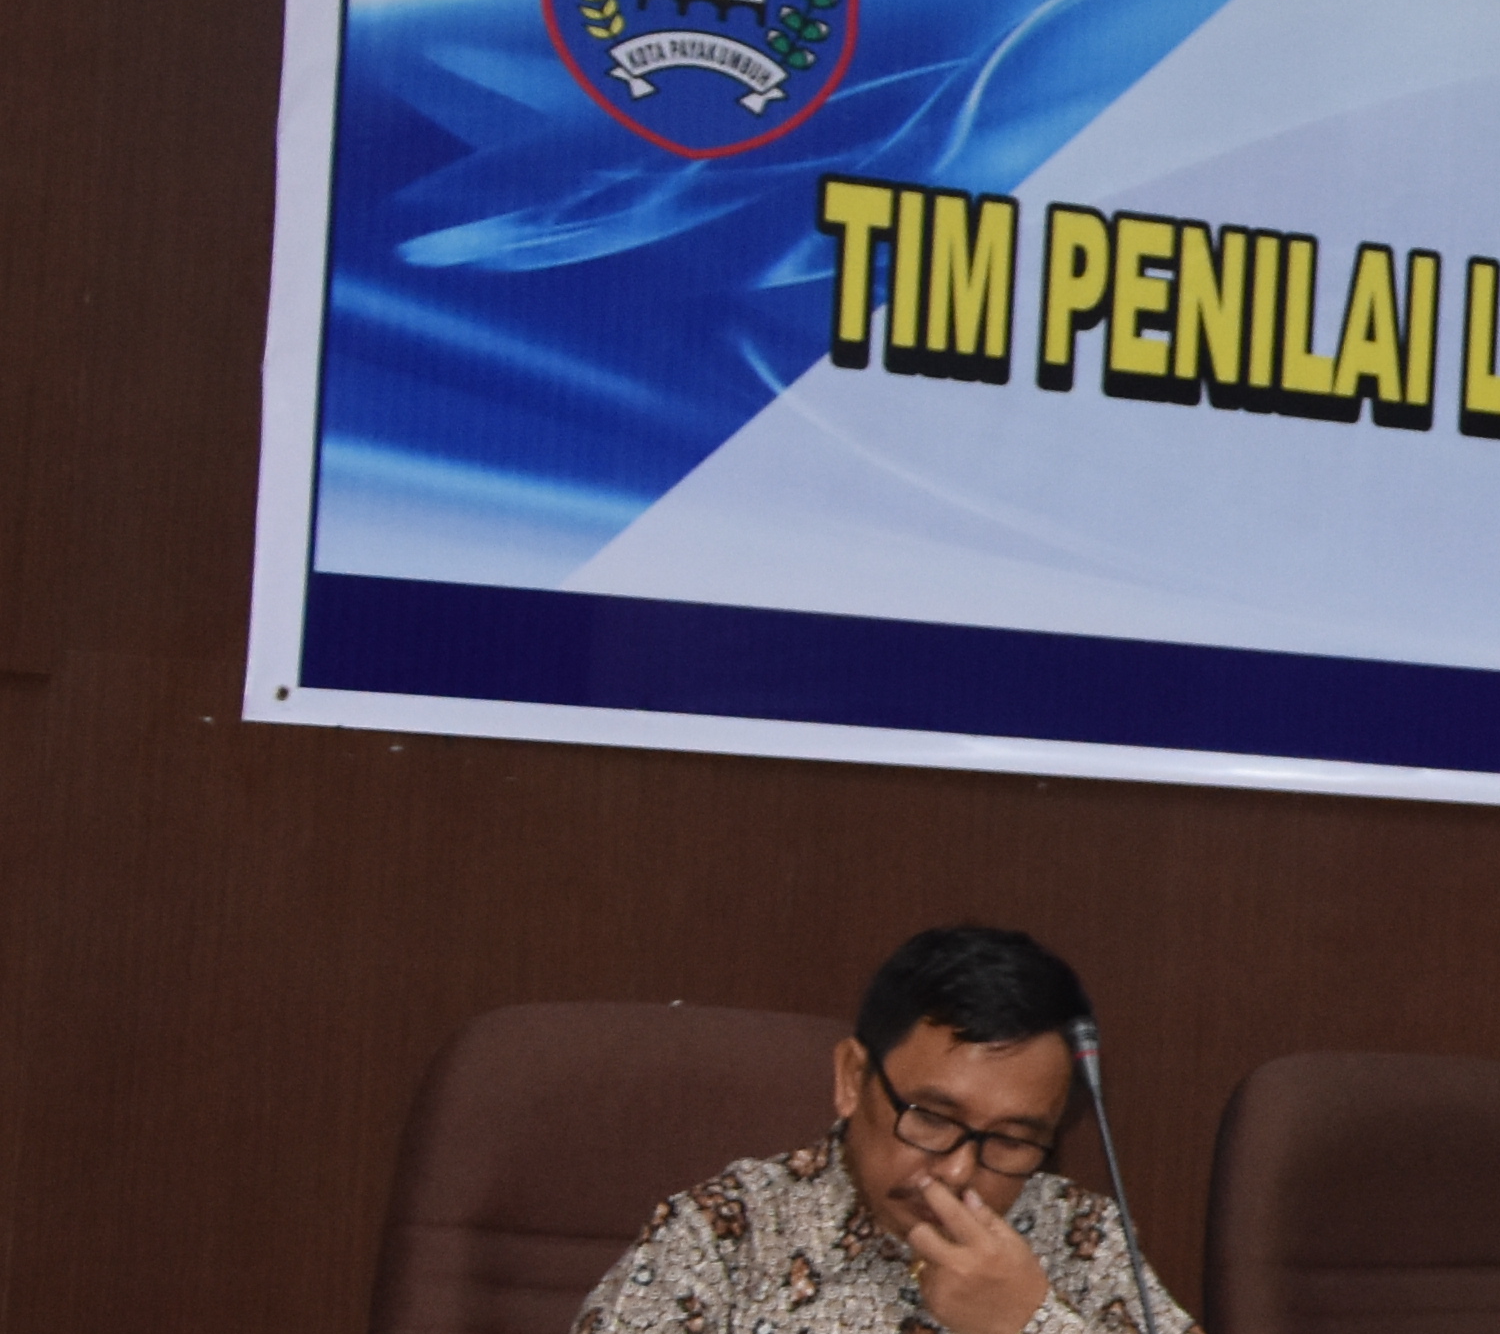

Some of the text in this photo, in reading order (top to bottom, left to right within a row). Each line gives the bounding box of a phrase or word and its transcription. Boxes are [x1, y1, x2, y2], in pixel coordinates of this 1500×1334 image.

[626, 38, 772, 87] KOTA PAYAKUMBUH
[819, 175, 1018, 369] TIM
[1039, 204, 1441, 416] PENILAI
